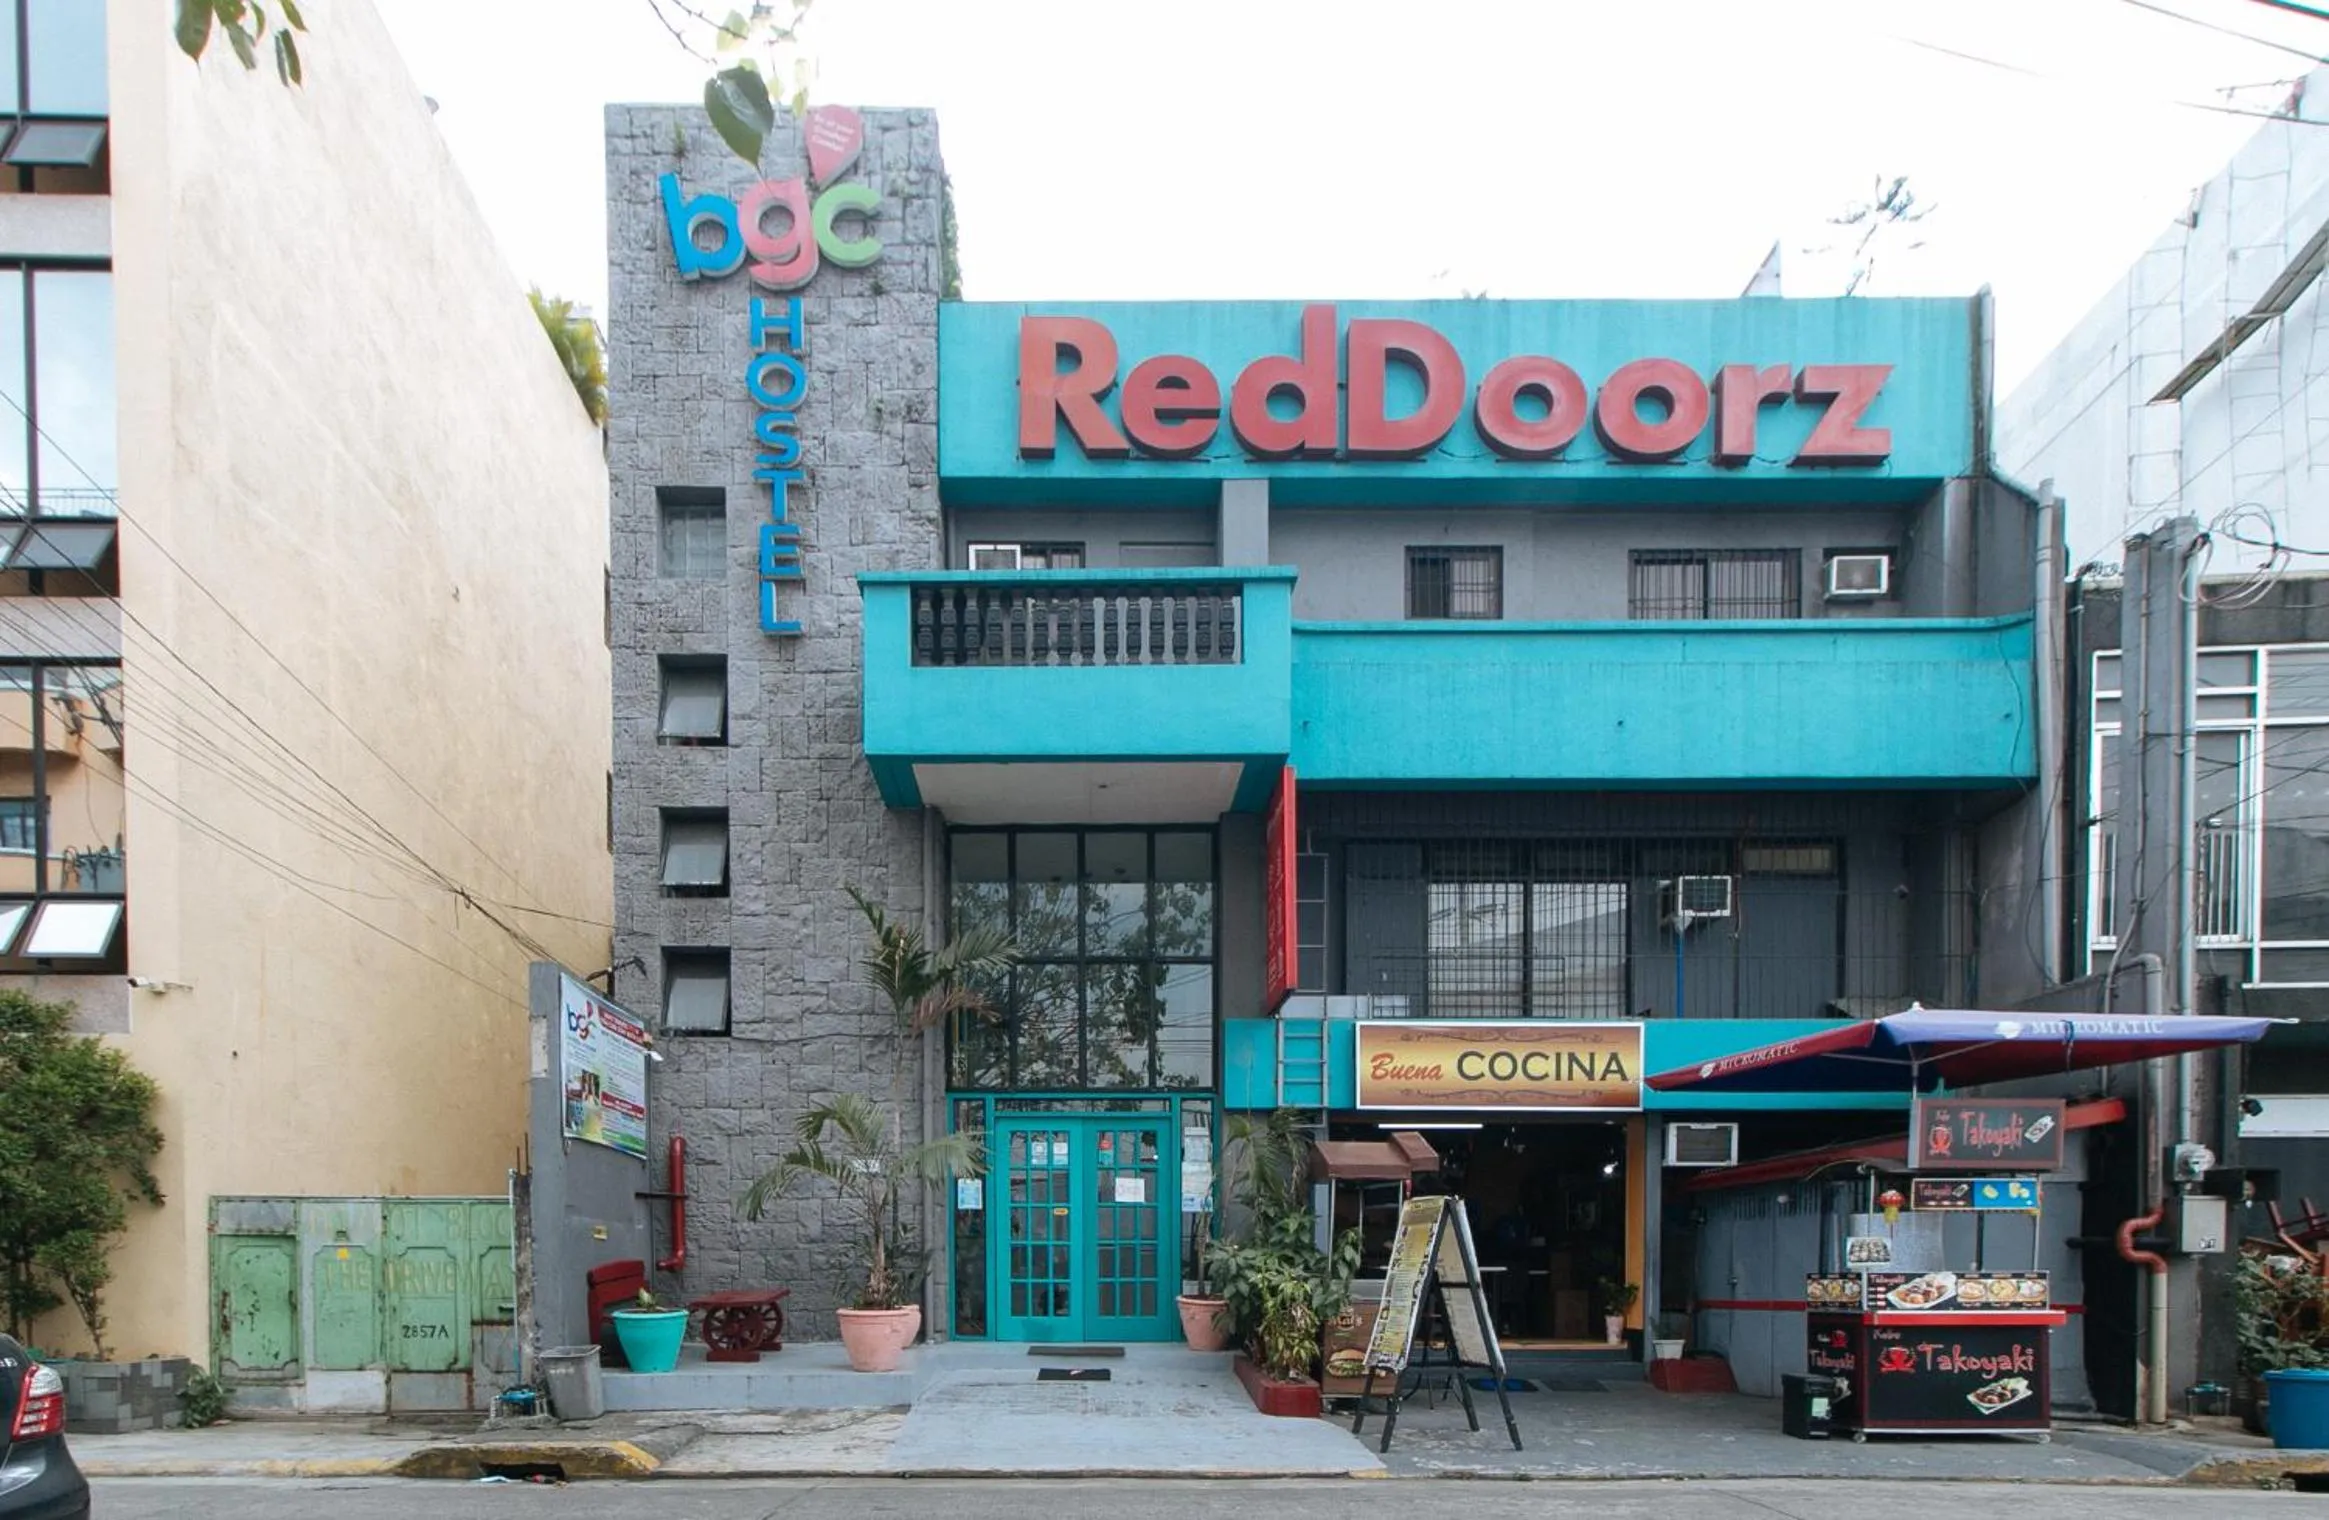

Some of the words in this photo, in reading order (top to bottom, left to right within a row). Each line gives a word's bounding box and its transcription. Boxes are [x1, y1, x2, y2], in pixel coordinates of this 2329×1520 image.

[659, 171, 886, 292] bgc
[1018, 303, 1896, 468] RedDoorz
[745, 296, 808, 638] HOSTEL
[1369, 1051, 1444, 1082] Buena
[1456, 1049, 1630, 1083] COCINA
[1958, 1109, 2024, 1158] Takoyaki
[401, 1324, 450, 1340] 2857A
[1916, 1342, 2035, 1380] Takoyaki
